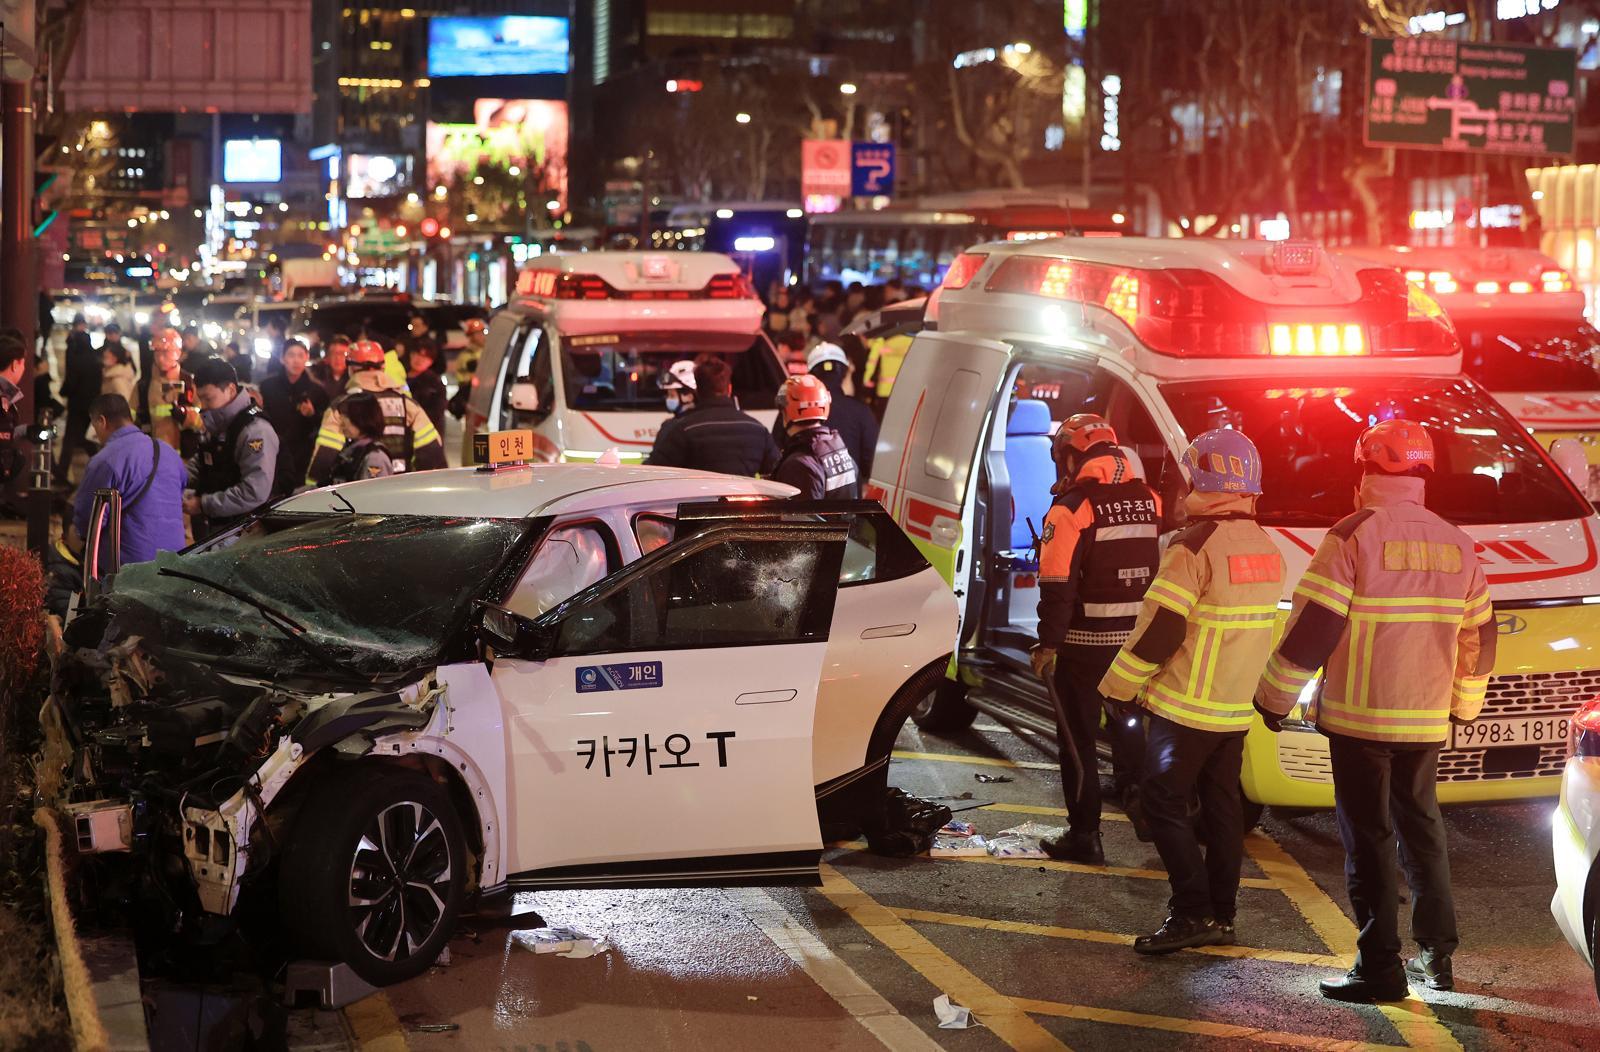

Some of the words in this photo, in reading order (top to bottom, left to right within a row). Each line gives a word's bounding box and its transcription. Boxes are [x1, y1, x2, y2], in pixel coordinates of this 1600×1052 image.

[500, 435, 524, 457] 인천
[1096, 499, 1155, 515] 119구조대
[1108, 513, 1152, 524] RESCUE
[628, 665, 656, 681] 개인
[1464, 723, 1514, 745] 998소
[1521, 719, 1568, 742] 1818
[576, 733, 700, 778] 카카오
[706, 731, 736, 768] T
